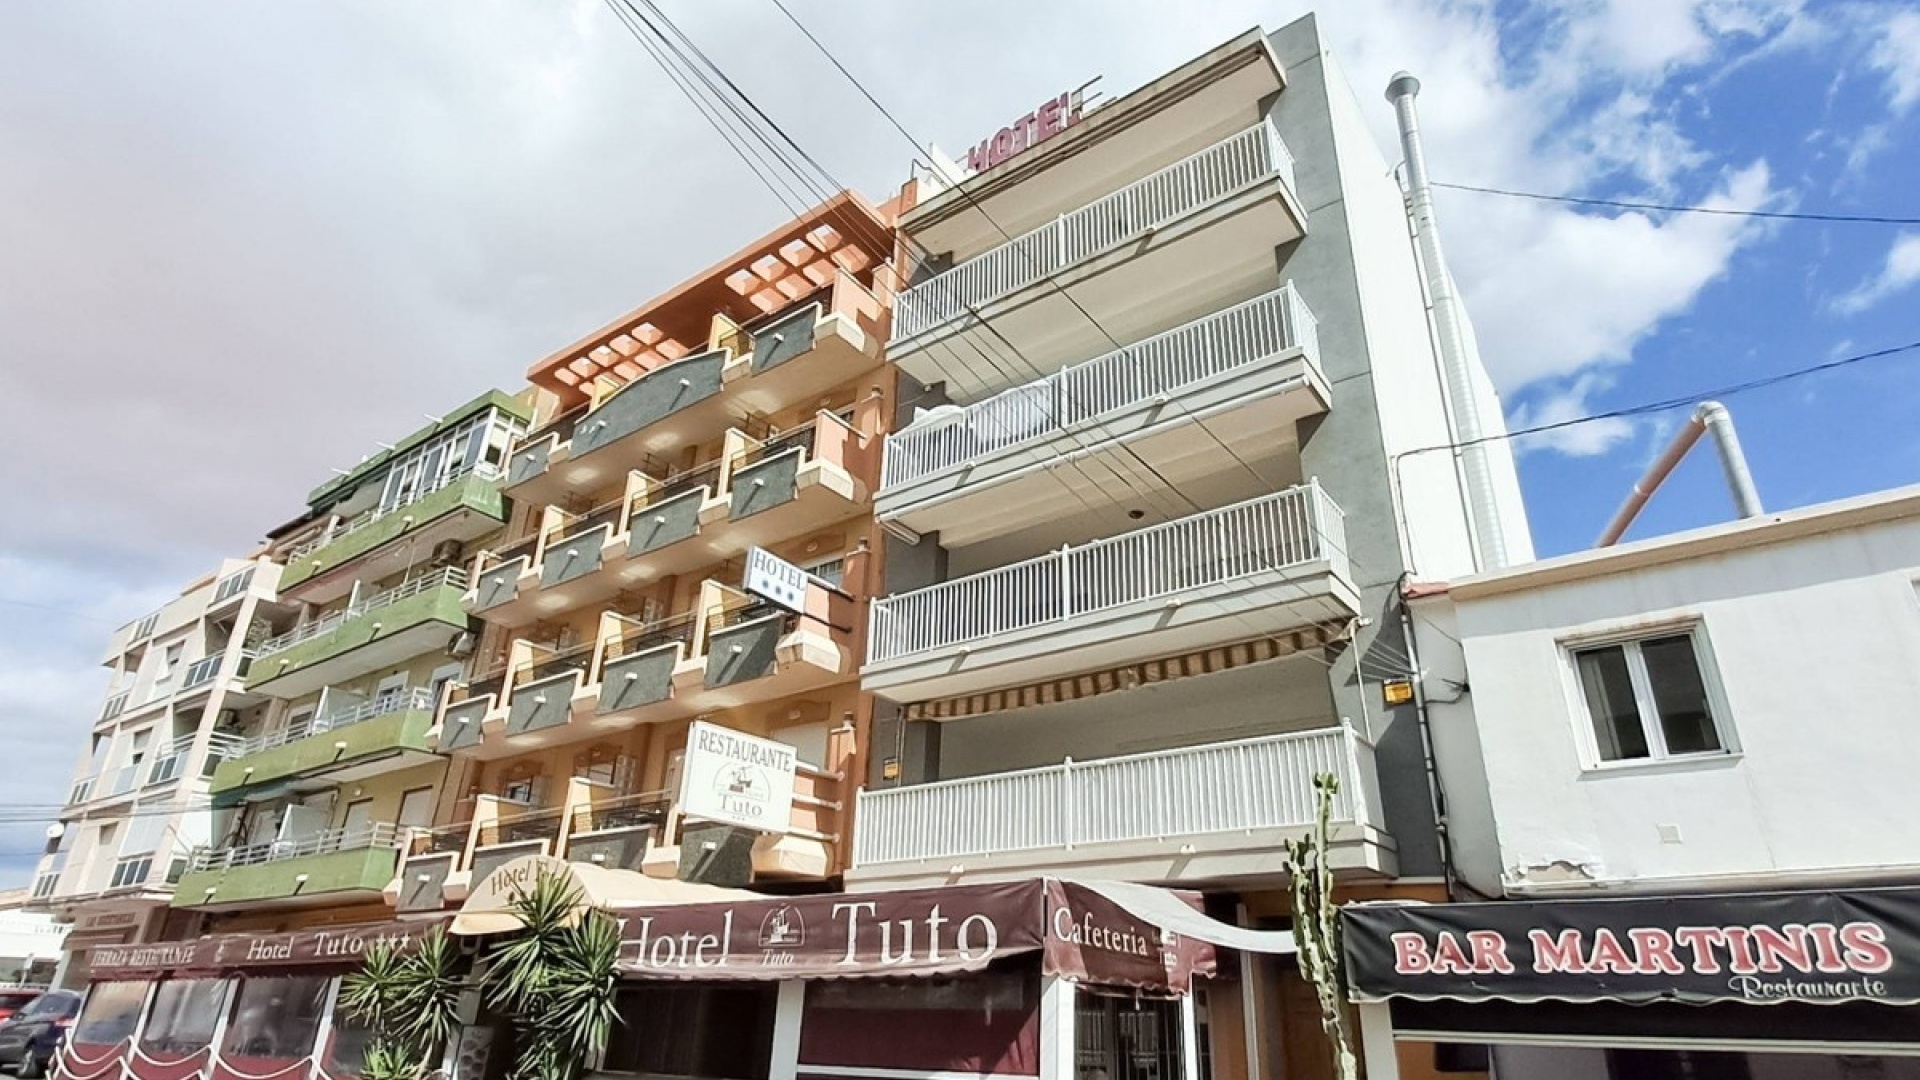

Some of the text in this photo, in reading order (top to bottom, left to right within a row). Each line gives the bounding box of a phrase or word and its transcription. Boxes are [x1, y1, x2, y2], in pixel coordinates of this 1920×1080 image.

[968, 92, 1082, 171] HOTEL
[753, 550, 806, 591] HOTEL
[698, 729, 792, 772] RESTAURANTE
[719, 793, 763, 816] Tuto
[491, 860, 532, 896] Hotel
[246, 931, 364, 960] Hotel Tuto
[611, 902, 999, 968] Hotel Tuto
[1053, 907, 1148, 956] Cafeteria
[1391, 921, 1893, 975] BAR MARTINIS
[761, 948, 795, 967] Tuto
